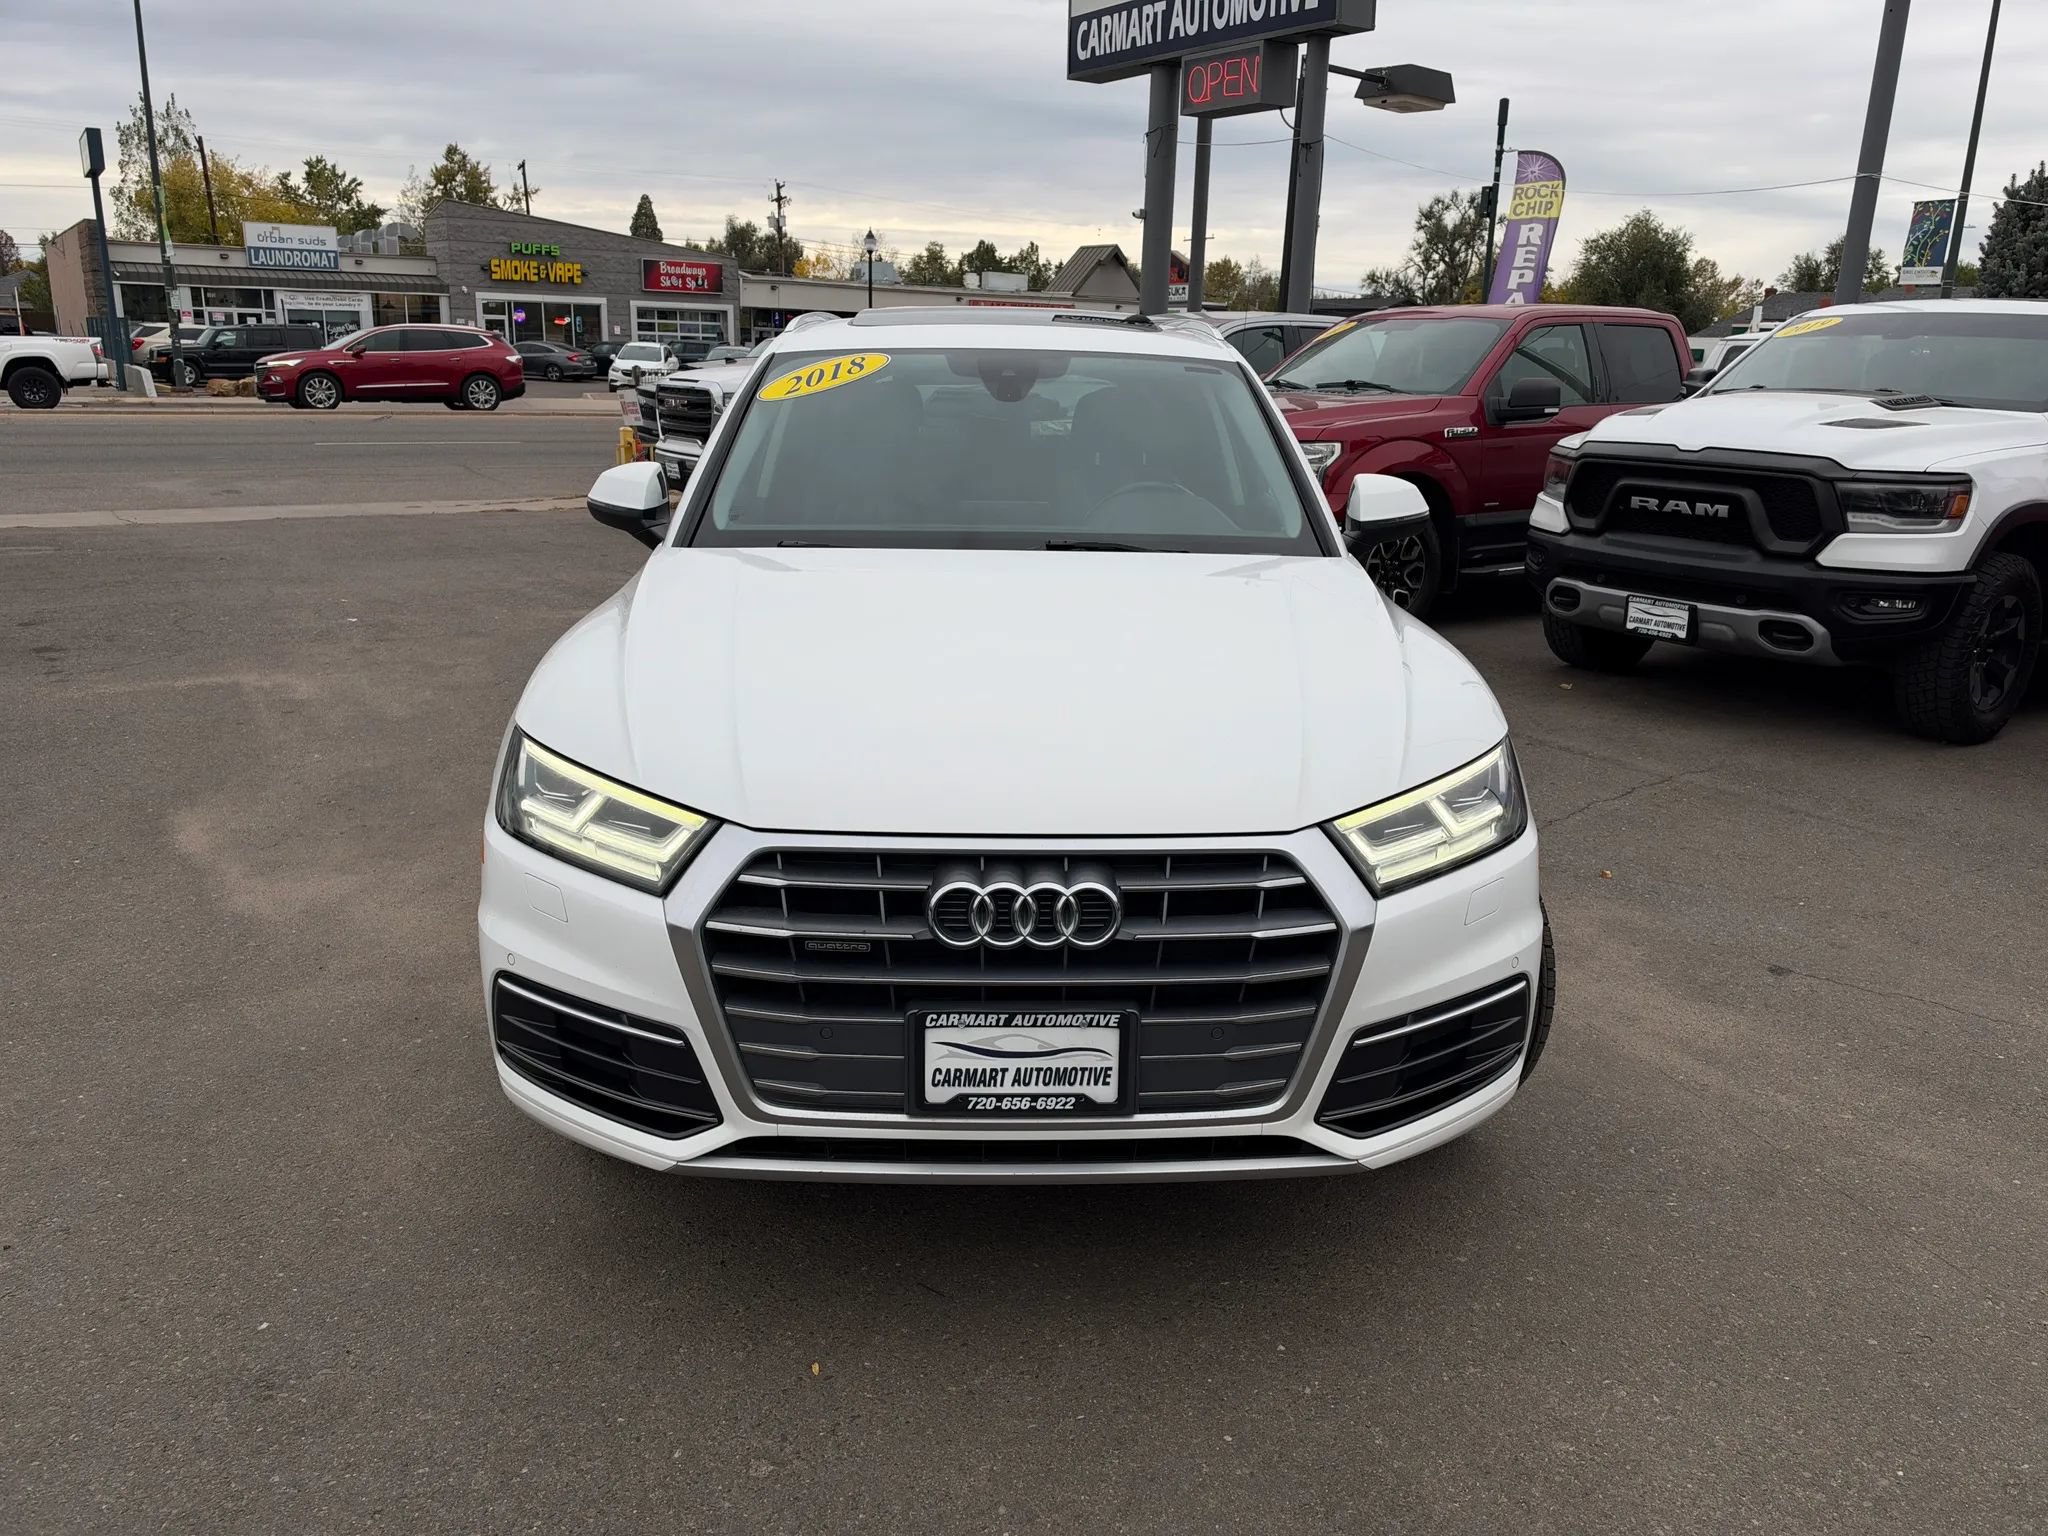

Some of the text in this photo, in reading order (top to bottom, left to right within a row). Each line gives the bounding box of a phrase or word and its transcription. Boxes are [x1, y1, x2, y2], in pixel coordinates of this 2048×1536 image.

[1076, 1, 1167, 60] CARMART
[1188, 55, 1260, 103] OPEN
[1513, 183, 1560, 200] ROCK
[1512, 201, 1554, 217] CHIP
[257, 230, 327, 246] urban suds
[511, 242, 560, 256] PUFFS
[250, 249, 335, 268] LAUNDROMAT
[490, 258, 582, 284] SMOKE & VAPE
[659, 261, 707, 278] Broadways
[783, 356, 866, 395] 2018
[1630, 496, 1730, 518] RAM
[1629, 595, 1689, 611] CARMART AUTOMOTIVE
[1629, 615, 1686, 632] CARMART AUTOMOTIVE
[925, 1013, 1120, 1027] CARMART AUTOMOTIVE
[931, 1066, 1113, 1088] CARMART AUTOMOTIVE
[967, 1097, 1075, 1110] 720-656-6922
